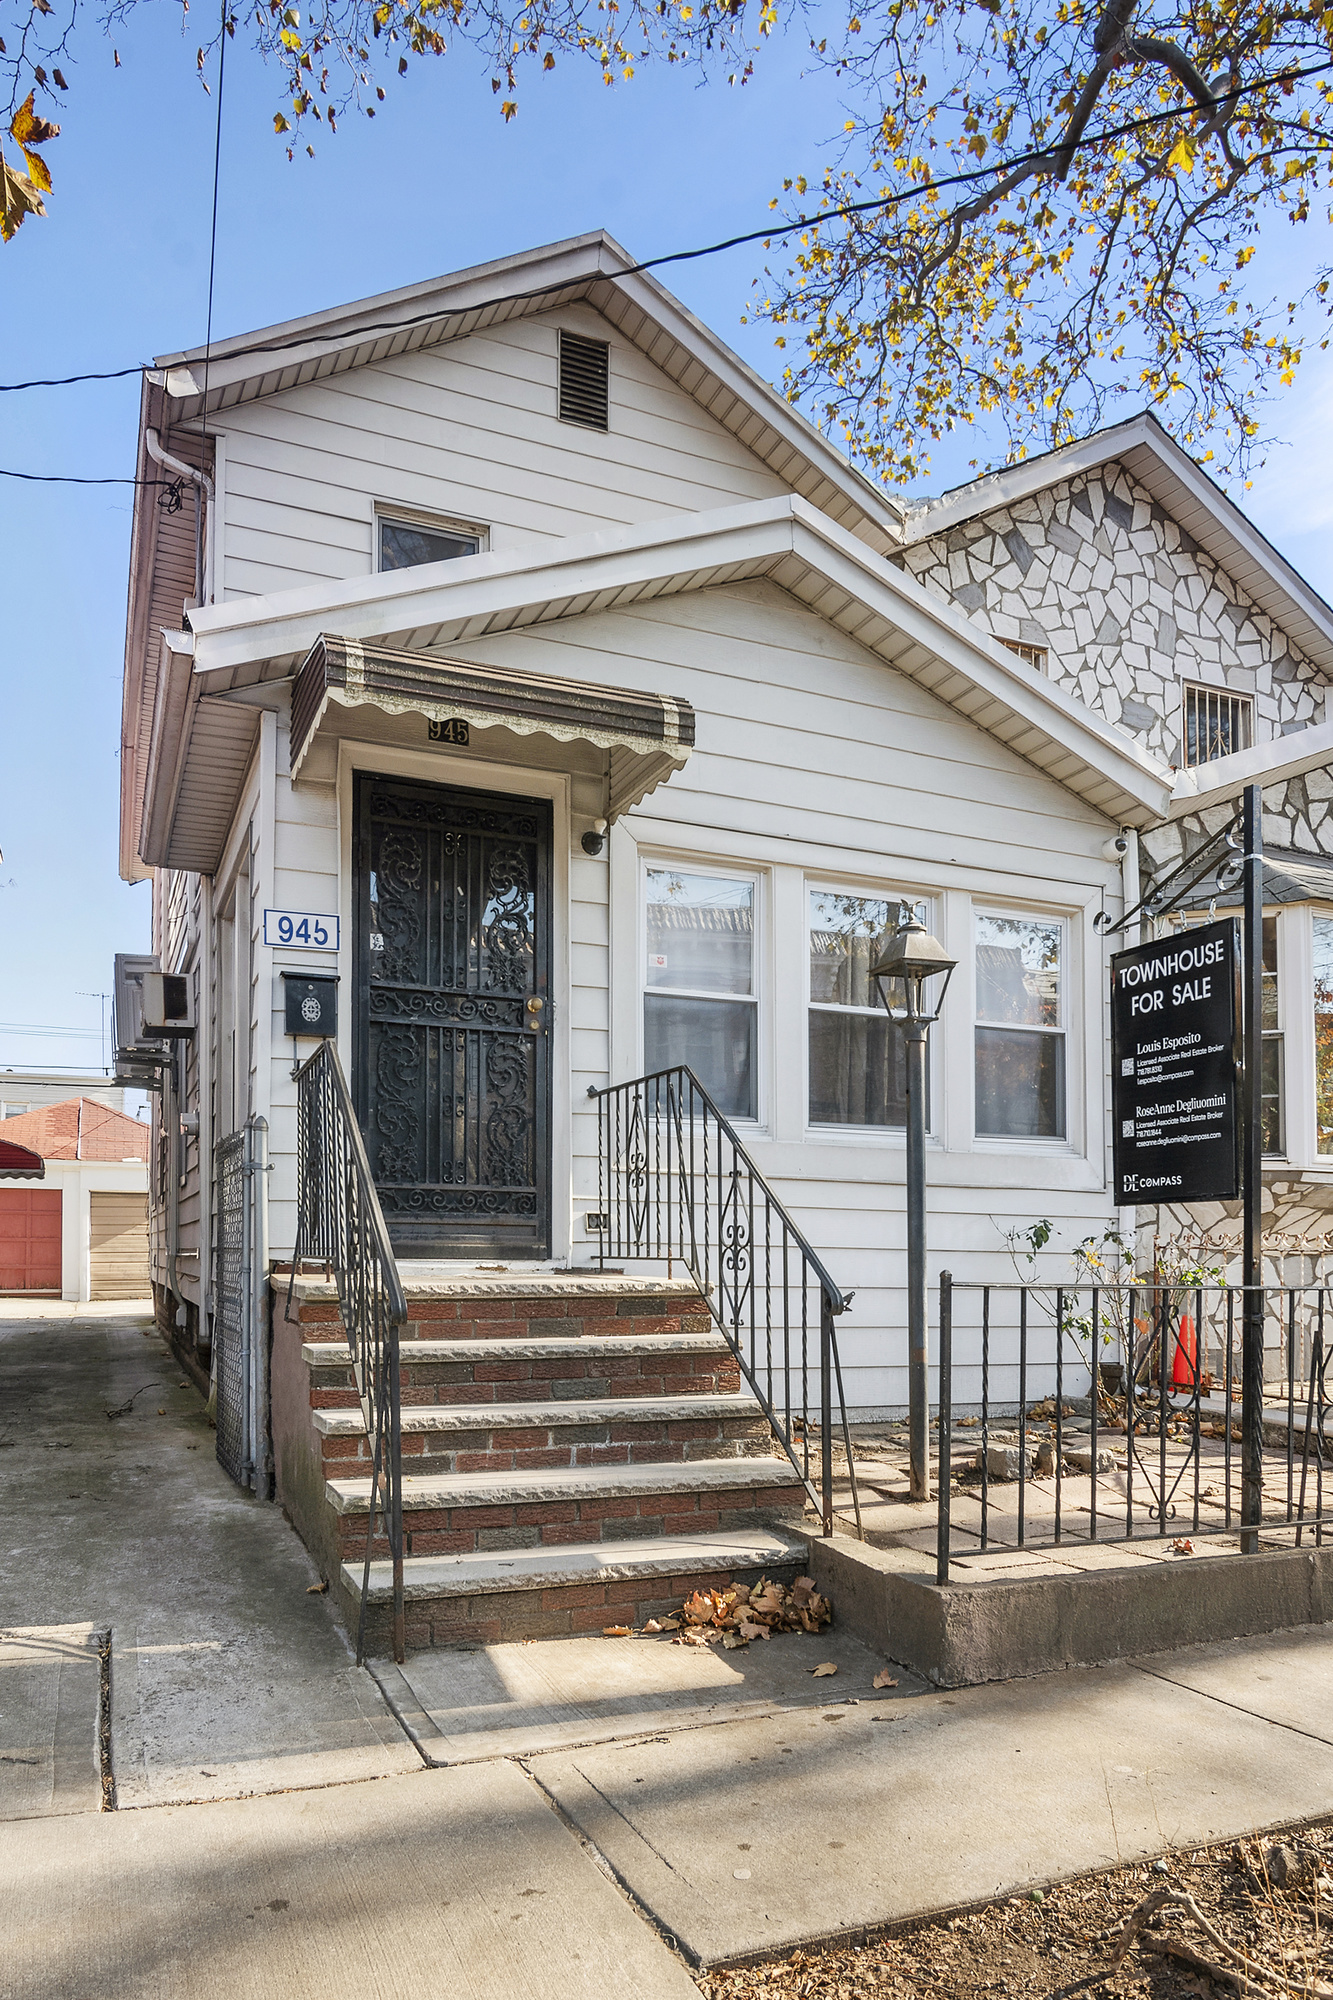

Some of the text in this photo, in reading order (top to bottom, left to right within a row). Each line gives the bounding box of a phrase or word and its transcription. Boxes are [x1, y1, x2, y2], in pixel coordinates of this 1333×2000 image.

[430, 720, 468, 743] 945
[278, 916, 328, 945] 945
[1120, 939, 1224, 988] TOWNHOUSE
[1131, 976, 1212, 1016] FOR SALE
[1137, 1032, 1201, 1055] Louis Esposito
[1137, 1044, 1224, 1067] Licensed Associate Real Estate Broker
[1136, 1093, 1226, 1118] RoseAnne Degliuomini
[1136, 1111, 1223, 1129] Licensed Associate Real Estate Broker
[1139, 1175, 1182, 1188] COMPASS
